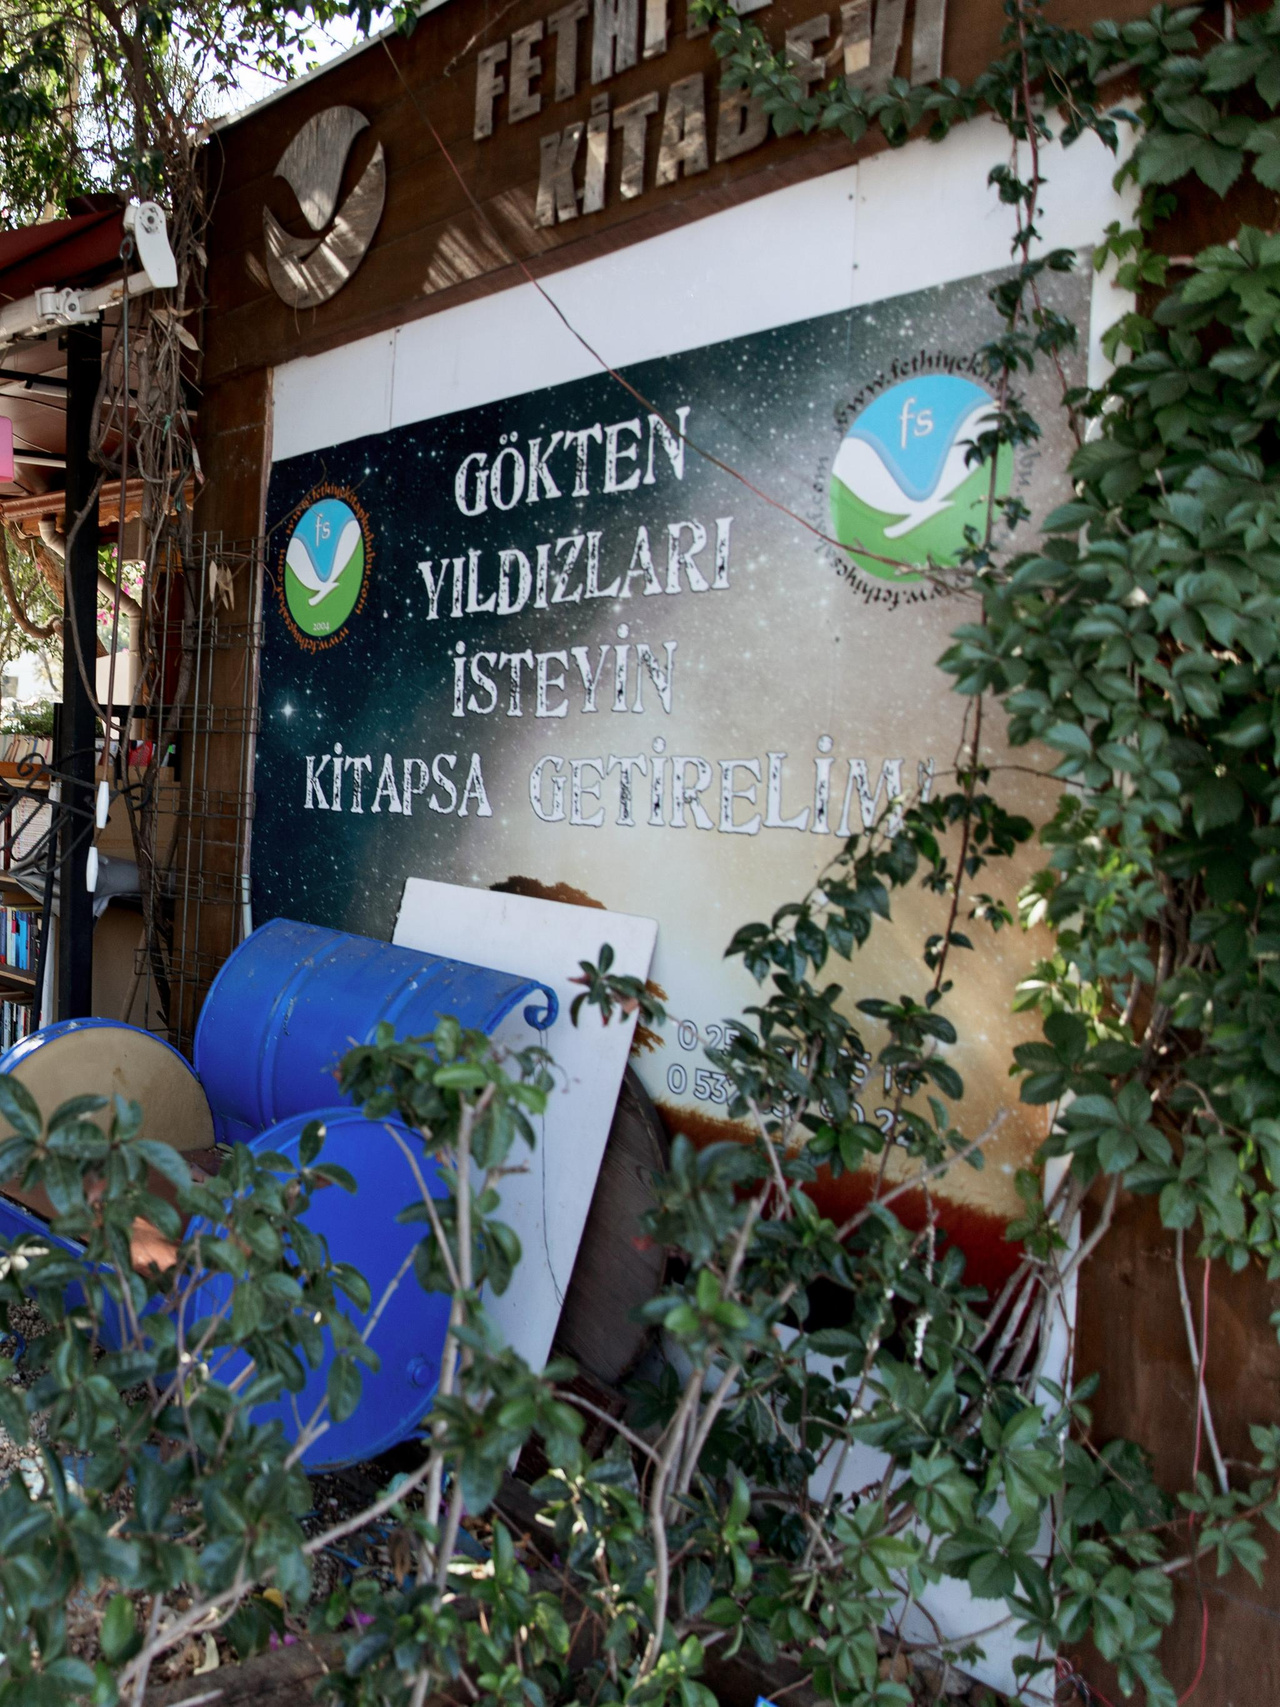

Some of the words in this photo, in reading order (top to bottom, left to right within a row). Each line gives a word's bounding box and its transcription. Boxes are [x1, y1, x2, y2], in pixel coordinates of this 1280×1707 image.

[899, 397, 935, 449] fs
[455, 406, 691, 516] GÖKTEN
[315, 512, 331, 547] fs
[418, 516, 734, 620] YILDIZLARI
[451, 623, 678, 718] İSTEYİN
[303, 742, 494, 818] KİTAPSA
[677, 1019, 699, 1051] 0
[667, 1063, 687, 1096] 0
